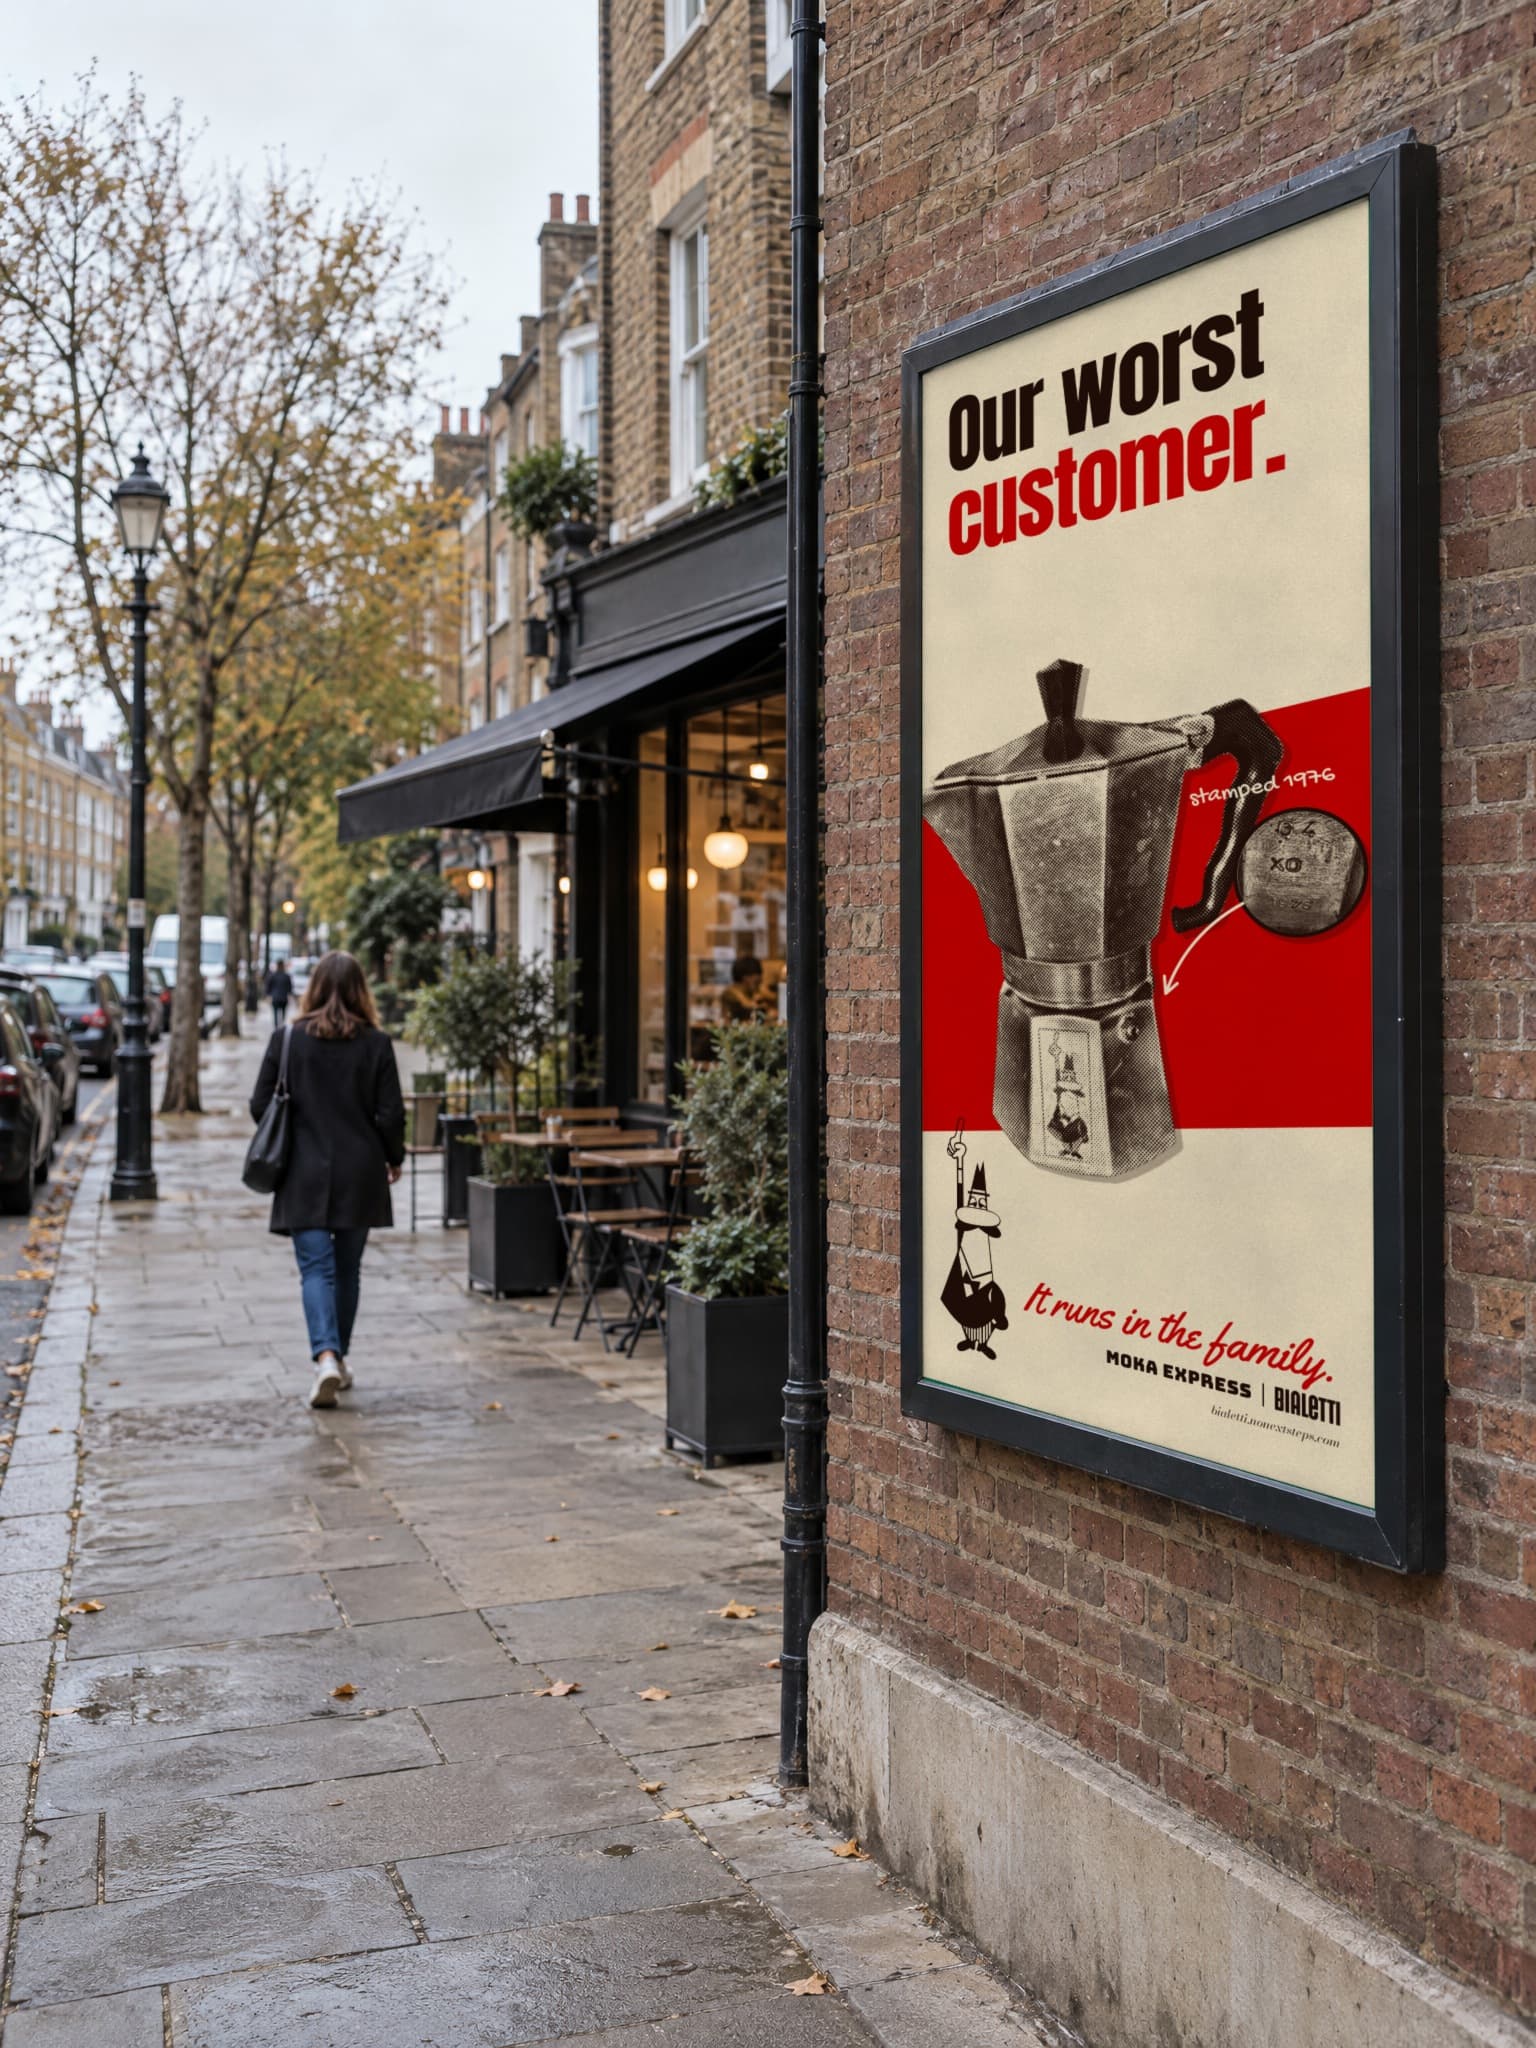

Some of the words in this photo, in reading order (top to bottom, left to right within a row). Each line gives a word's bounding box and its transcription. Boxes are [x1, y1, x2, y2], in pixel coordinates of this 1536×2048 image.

[949, 378, 1044, 472] Our
[1061, 288, 1265, 436] worst
[949, 399, 1286, 556] customer.
[1189, 775, 1281, 807] stamped
[1283, 767, 1336, 788] 1976
[1023, 1282, 1053, 1315] It
[1050, 1300, 1116, 1330] runs
[1121, 1308, 1152, 1339] in
[1157, 1311, 1202, 1350] the
[1203, 1321, 1333, 1390] family.
[1106, 1349, 1158, 1376] MOKA
[1163, 1363, 1252, 1399] EXPRESS
[1210, 1404, 1340, 1449] bialetti.nonextsteps.com
